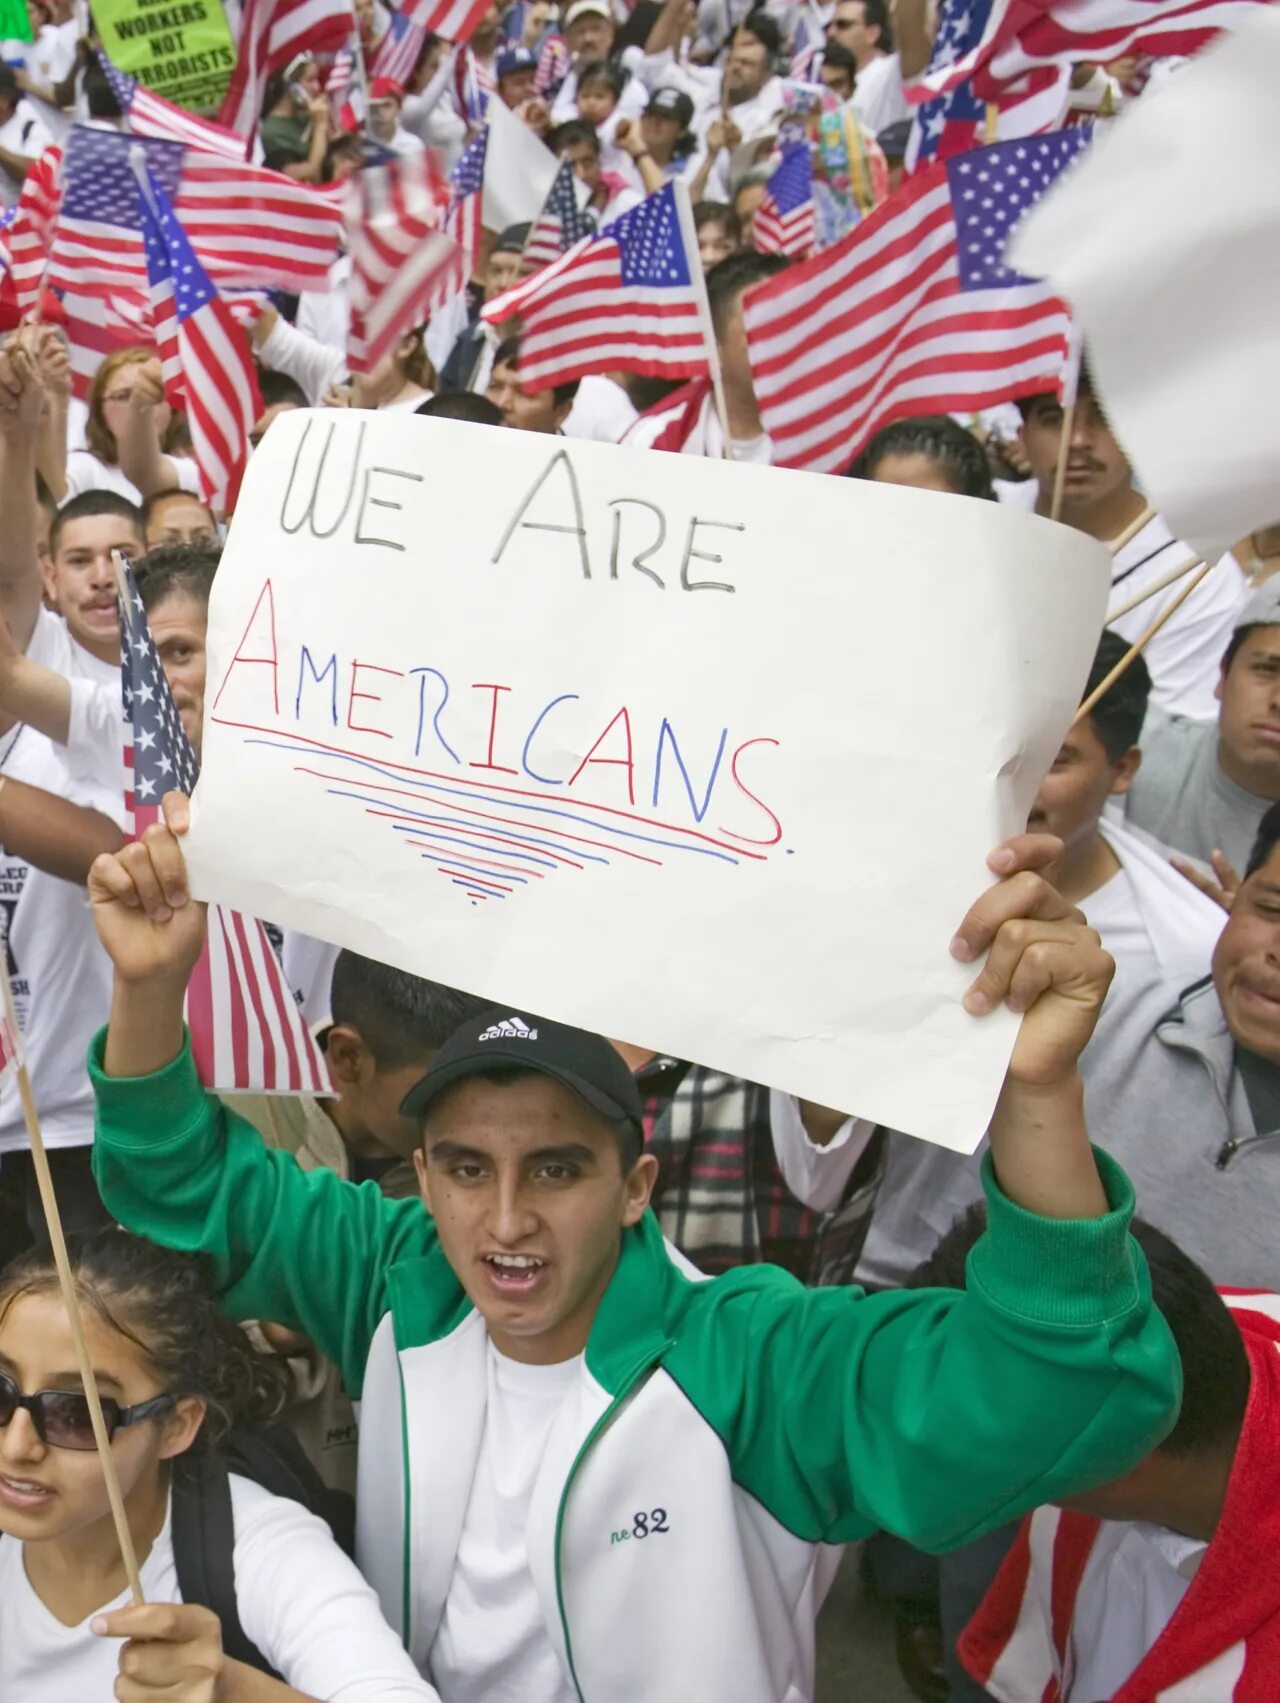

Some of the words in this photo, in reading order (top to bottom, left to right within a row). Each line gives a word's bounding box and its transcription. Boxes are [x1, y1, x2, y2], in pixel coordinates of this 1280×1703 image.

[114, 1, 207, 40] WORKERS
[149, 30, 186, 57] NOT
[280, 418, 424, 551] WE
[491, 449, 746, 592] ARE
[478, 1028, 538, 1041] adidas
